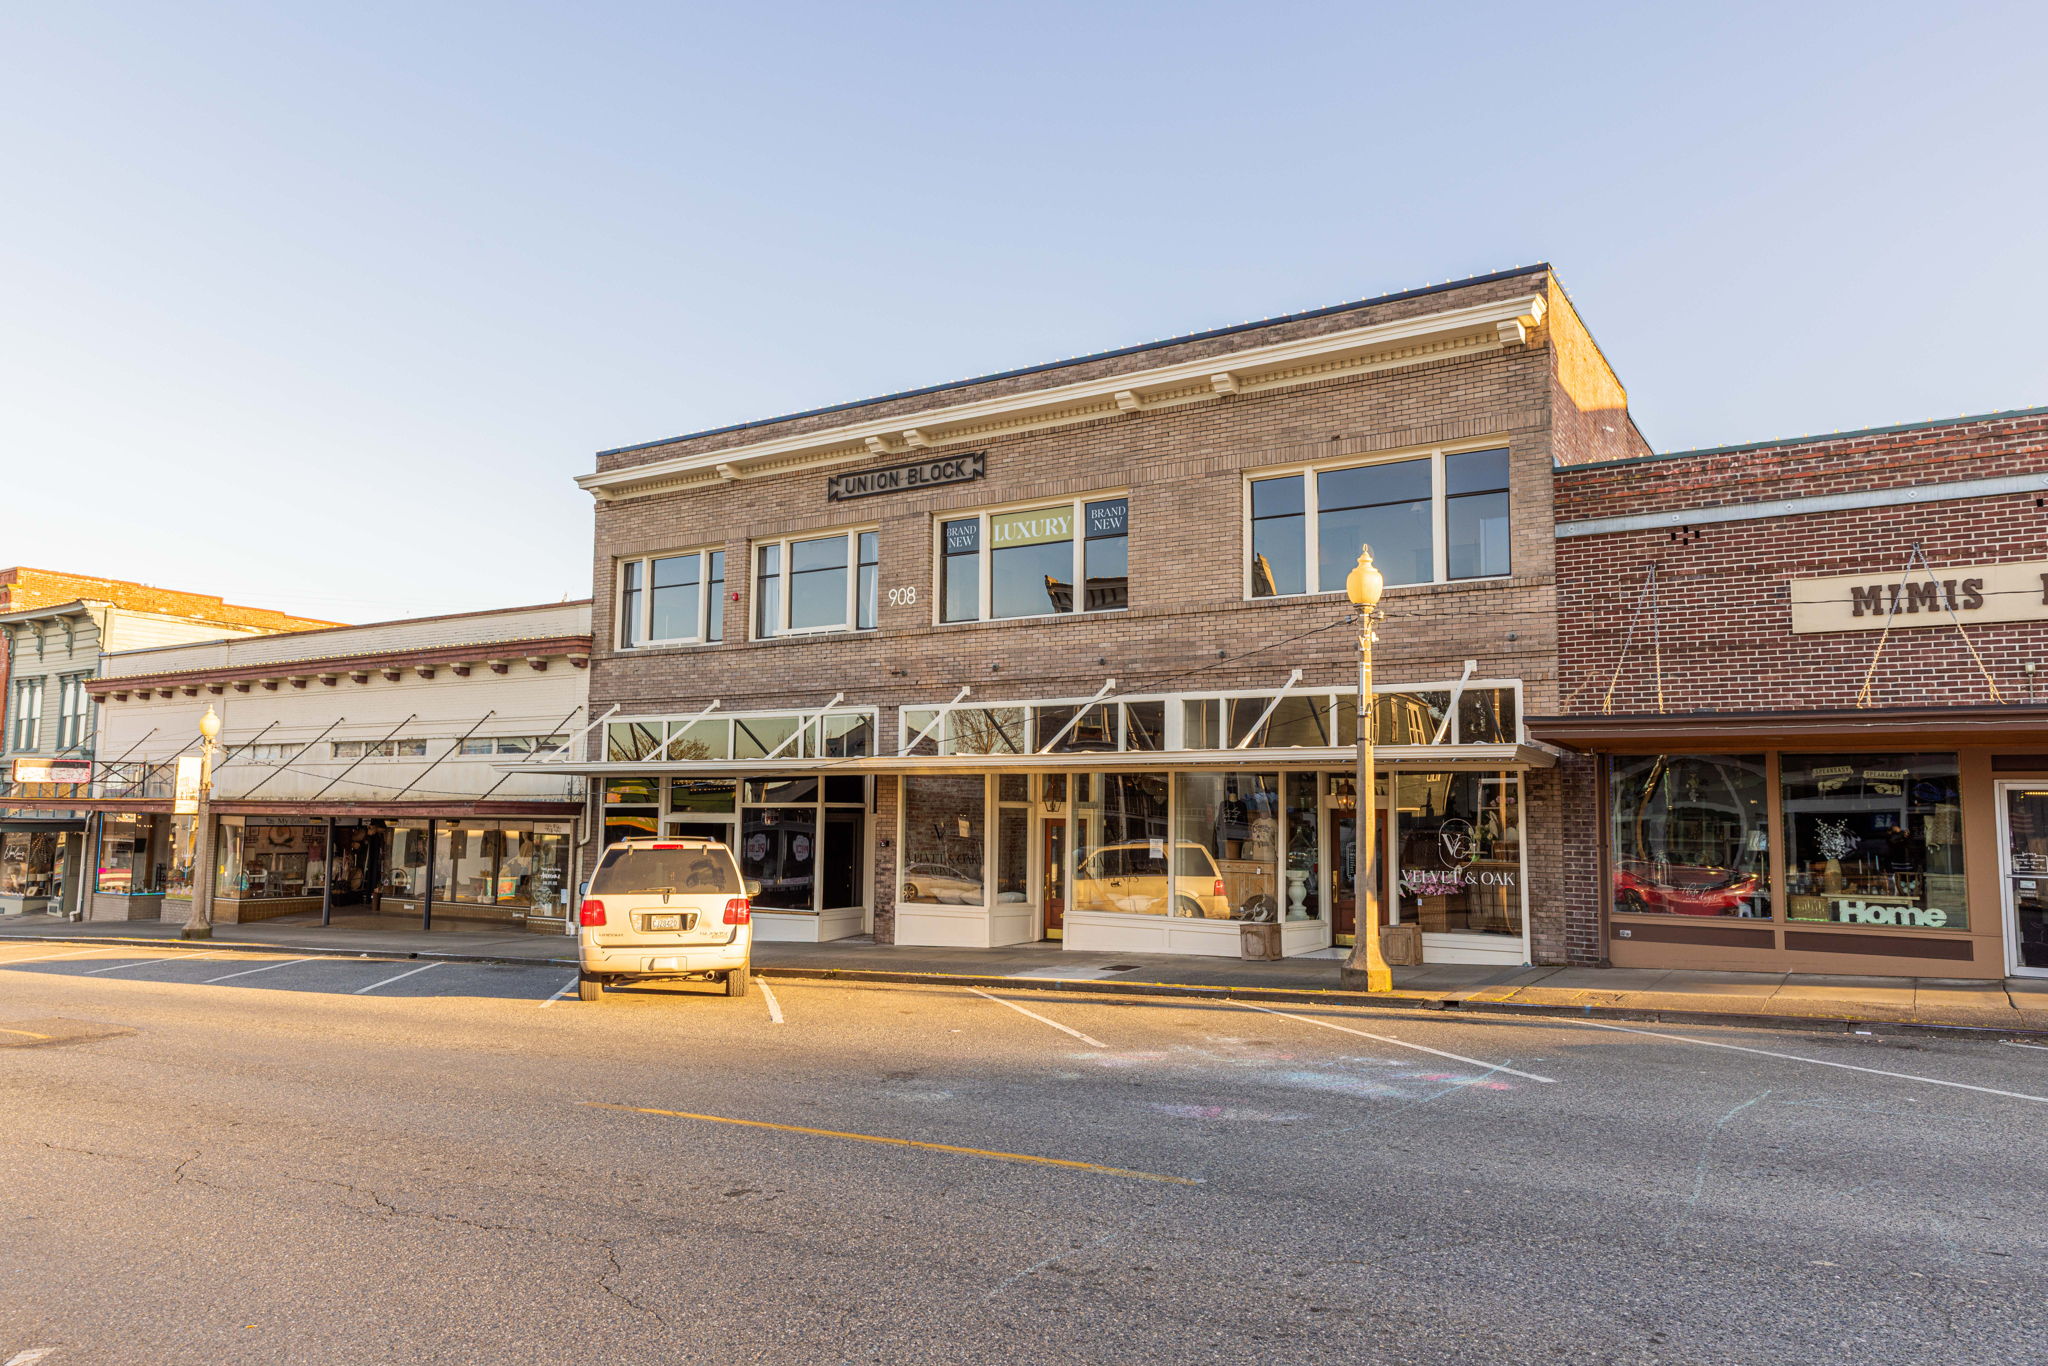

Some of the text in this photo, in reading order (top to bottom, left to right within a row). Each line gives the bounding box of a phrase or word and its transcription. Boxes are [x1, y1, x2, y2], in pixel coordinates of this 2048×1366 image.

[844, 459, 967, 495] UNION BLOCK
[1091, 505, 1126, 519] BRAND
[946, 525, 977, 538] BRAND
[993, 515, 1072, 542] LUXURY
[1094, 517, 1123, 531] NEW
[949, 536, 975, 549] NEW
[888, 586, 916, 607] 908
[1851, 578, 1984, 617] MIMIS
[1401, 869, 1516, 887] VELVET & OAK
[1839, 900, 1948, 928] Home
